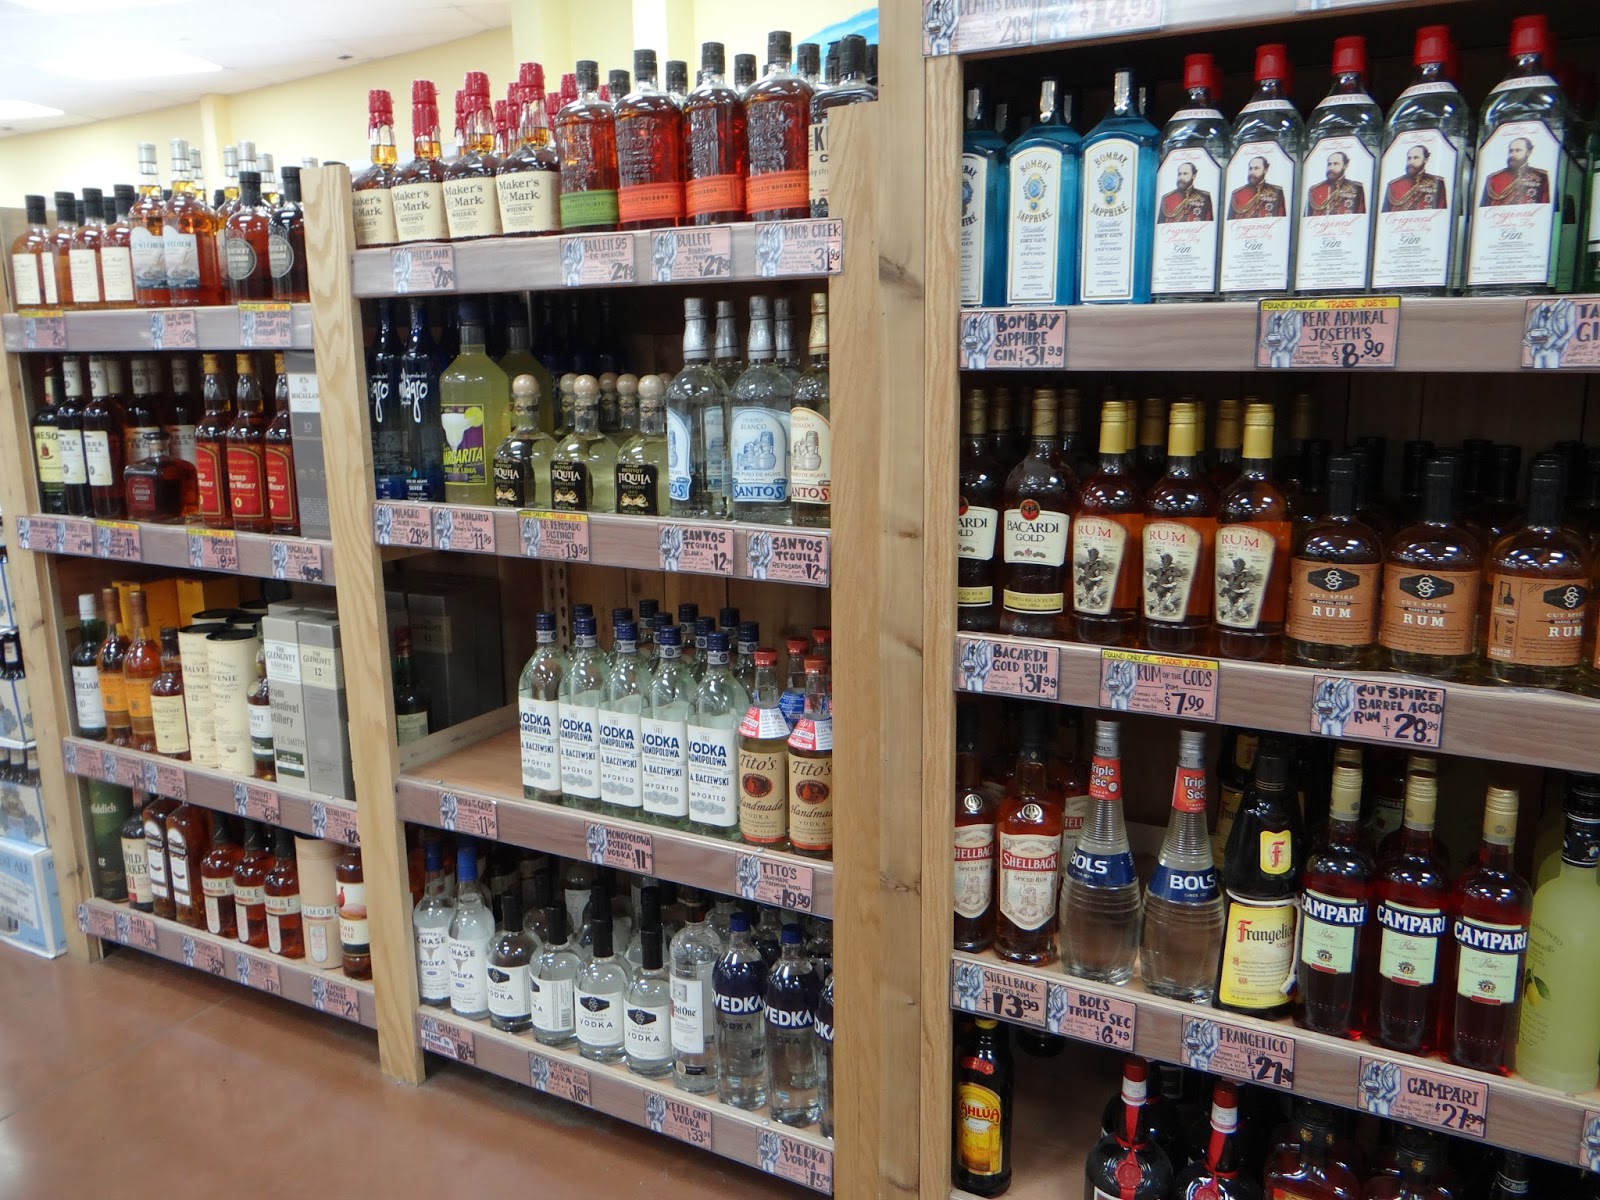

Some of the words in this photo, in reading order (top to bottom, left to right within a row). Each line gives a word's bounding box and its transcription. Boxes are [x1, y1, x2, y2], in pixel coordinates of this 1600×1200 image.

[1093, 151, 1129, 168] BOMBAY
[1020, 159, 1053, 177] BOMBAY
[444, 183, 483, 197] Maker's
[499, 178, 540, 190] Maker's
[393, 190, 429, 202] Maker's
[454, 194, 485, 207] Mark
[509, 190, 541, 202] Mark
[358, 207, 383, 217] Mark
[402, 201, 431, 212] Mark
[1090, 201, 1130, 218] SAPPHIRE
[1016, 208, 1053, 223] SAPPHIRE
[1385, 209, 1439, 227] Original
[1484, 205, 1546, 223] Original
[1230, 219, 1281, 236] Original
[1307, 214, 1361, 231] Original
[784, 224, 809, 240] KNOB
[811, 223, 840, 238] CREEK
[1398, 232, 1421, 245] Gin
[1498, 228, 1522, 241] Gin
[677, 232, 712, 247] BULLEIT
[1242, 239, 1263, 251] Gin
[1320, 237, 1342, 249] Gin
[1263, 301, 1288, 309] FOUND
[1291, 301, 1309, 309] ONLY
[1325, 300, 1358, 309] TRADER
[1361, 299, 1387, 307] JOE'S
[996, 313, 1060, 332] BOMBAY
[1302, 311, 1331, 327] REAR
[1334, 310, 1388, 326] ADMIRAL
[995, 332, 1048, 348] SAPPHIRE
[1309, 327, 1372, 342] JOSEPH'S
[993, 348, 1017, 362] GIN
[552, 469, 581, 482] TEQUILA
[618, 472, 652, 485] TEQUILA
[733, 484, 784, 499] SANTOS
[791, 485, 831, 501] ANTOS
[392, 508, 420, 519] MILAGRO
[460, 512, 489, 523] MARGARITA
[551, 521, 582, 531] REPOSADO
[959, 517, 988, 528] ARDI
[1007, 519, 1059, 533] BACARDI
[682, 529, 726, 544] SANTOS
[1015, 533, 1045, 542] GOLD
[1078, 524, 1111, 539] RUM
[1149, 530, 1186, 544] RUM
[684, 541, 718, 551] TEQUILA
[772, 537, 823, 554] SANTOS
[1221, 534, 1260, 549] RUM
[775, 551, 820, 563] TEQUILA
[772, 562, 803, 570] REPOSADO
[1312, 605, 1352, 618] RUM
[1402, 613, 1445, 627] RUM
[266, 651, 296, 663] GLENLIVET
[993, 644, 1048, 662] BACARDI
[1103, 651, 1126, 660] FOUND
[1156, 657, 1184, 666] TRADER
[1186, 660, 1208, 668] JOE'S
[302, 655, 331, 666] GLENLIVET
[992, 659, 1020, 672] GOLD
[1024, 663, 1048, 674] RUM
[184, 665, 209, 673] BALVE
[314, 667, 322, 676] 12
[1137, 664, 1161, 683] RUM
[1183, 669, 1212, 687] GODS
[1165, 683, 1179, 691] RUM
[1356, 684, 1387, 698] CUT
[1388, 687, 1437, 701] SPIKE
[1358, 698, 1404, 712] BARREL
[1408, 701, 1443, 715] AGED
[1354, 711, 1380, 724] RUM
[525, 741, 553, 754] BACZEWSKI
[566, 748, 596, 760] BACZEWSKI
[605, 756, 637, 769] BACZEWSKI
[739, 753, 777, 771] Tito's
[792, 760, 832, 777] Tito's
[649, 764, 683, 777] BACZEWSKI
[1091, 762, 1115, 777] Triple
[695, 773, 729, 786] BACZEWSKI
[1090, 775, 1107, 787] Sec
[1186, 789, 1204, 799] Sec
[744, 811, 770, 820] VODKA
[606, 828, 651, 846] MONOPOLOWA
[608, 839, 633, 851] POTATO
[607, 848, 631, 859] VODKA
[1003, 853, 1056, 869] SHELLBACK
[1070, 850, 1108, 875] BOLS
[125, 864, 148, 874] RKEY
[760, 862, 797, 880] TITO'S
[204, 880, 230, 889] MORE
[1013, 875, 1035, 883] SPICED
[1169, 874, 1216, 890] BOLS
[266, 898, 293, 908] MORE
[1302, 892, 1364, 923] CAMPARI
[1377, 904, 1447, 934] CAMPARI
[1454, 921, 1528, 951] CAMPARI
[983, 970, 1039, 994] SHELLBACK
[992, 984, 1014, 996] SPICED
[1015, 989, 1030, 999] RUM
[1079, 993, 1110, 1012] BOLS
[682, 1006, 696, 1016] One
[1067, 1004, 1106, 1023] TRIPLE
[1109, 1013, 1132, 1029] SEC
[579, 1018, 613, 1029] VODKA
[627, 1032, 660, 1043] VODKA
[1219, 1026, 1288, 1054] FRANGELICO
[1407, 1077, 1480, 1107] CAMPARI
[665, 1100, 690, 1117] KETEL
[692, 1110, 709, 1122] ONE
[960, 1101, 1000, 1125] AHLÚA
[673, 1113, 700, 1128] VODKA
[781, 1139, 826, 1164] SVEDKA
[784, 1152, 817, 1172] VODKA
